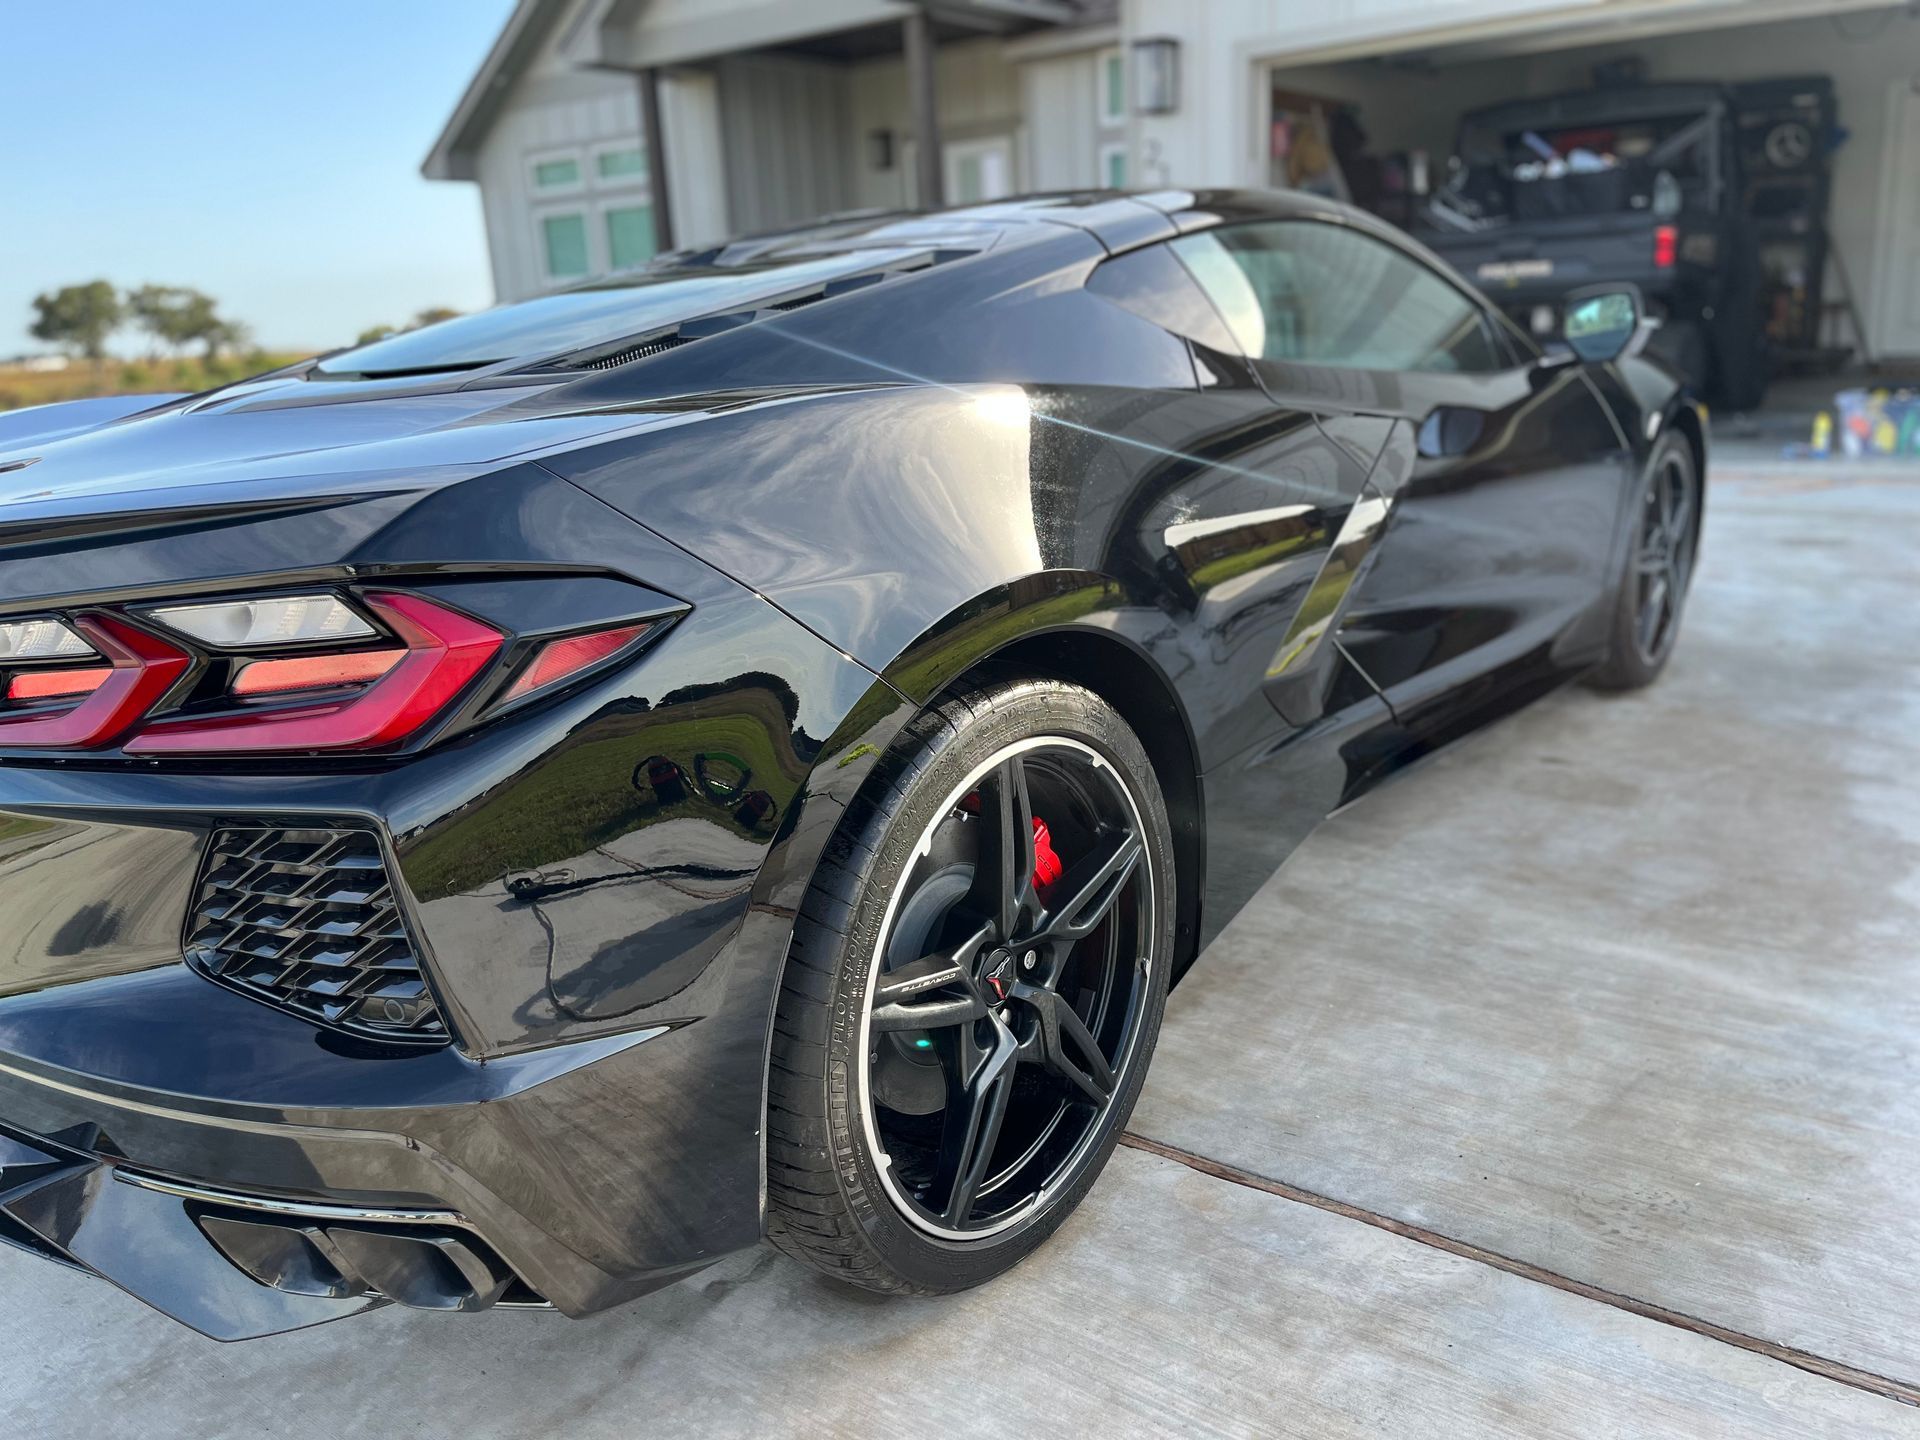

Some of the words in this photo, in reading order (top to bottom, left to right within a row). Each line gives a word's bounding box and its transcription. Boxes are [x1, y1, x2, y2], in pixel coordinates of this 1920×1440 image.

[833, 991, 850, 1044] PILOT
[842, 919, 867, 983] SPORT
[863, 878, 880, 914] ALL
[901, 972, 957, 993] CORVETTE
[830, 1071, 878, 1223] MICHELIN
